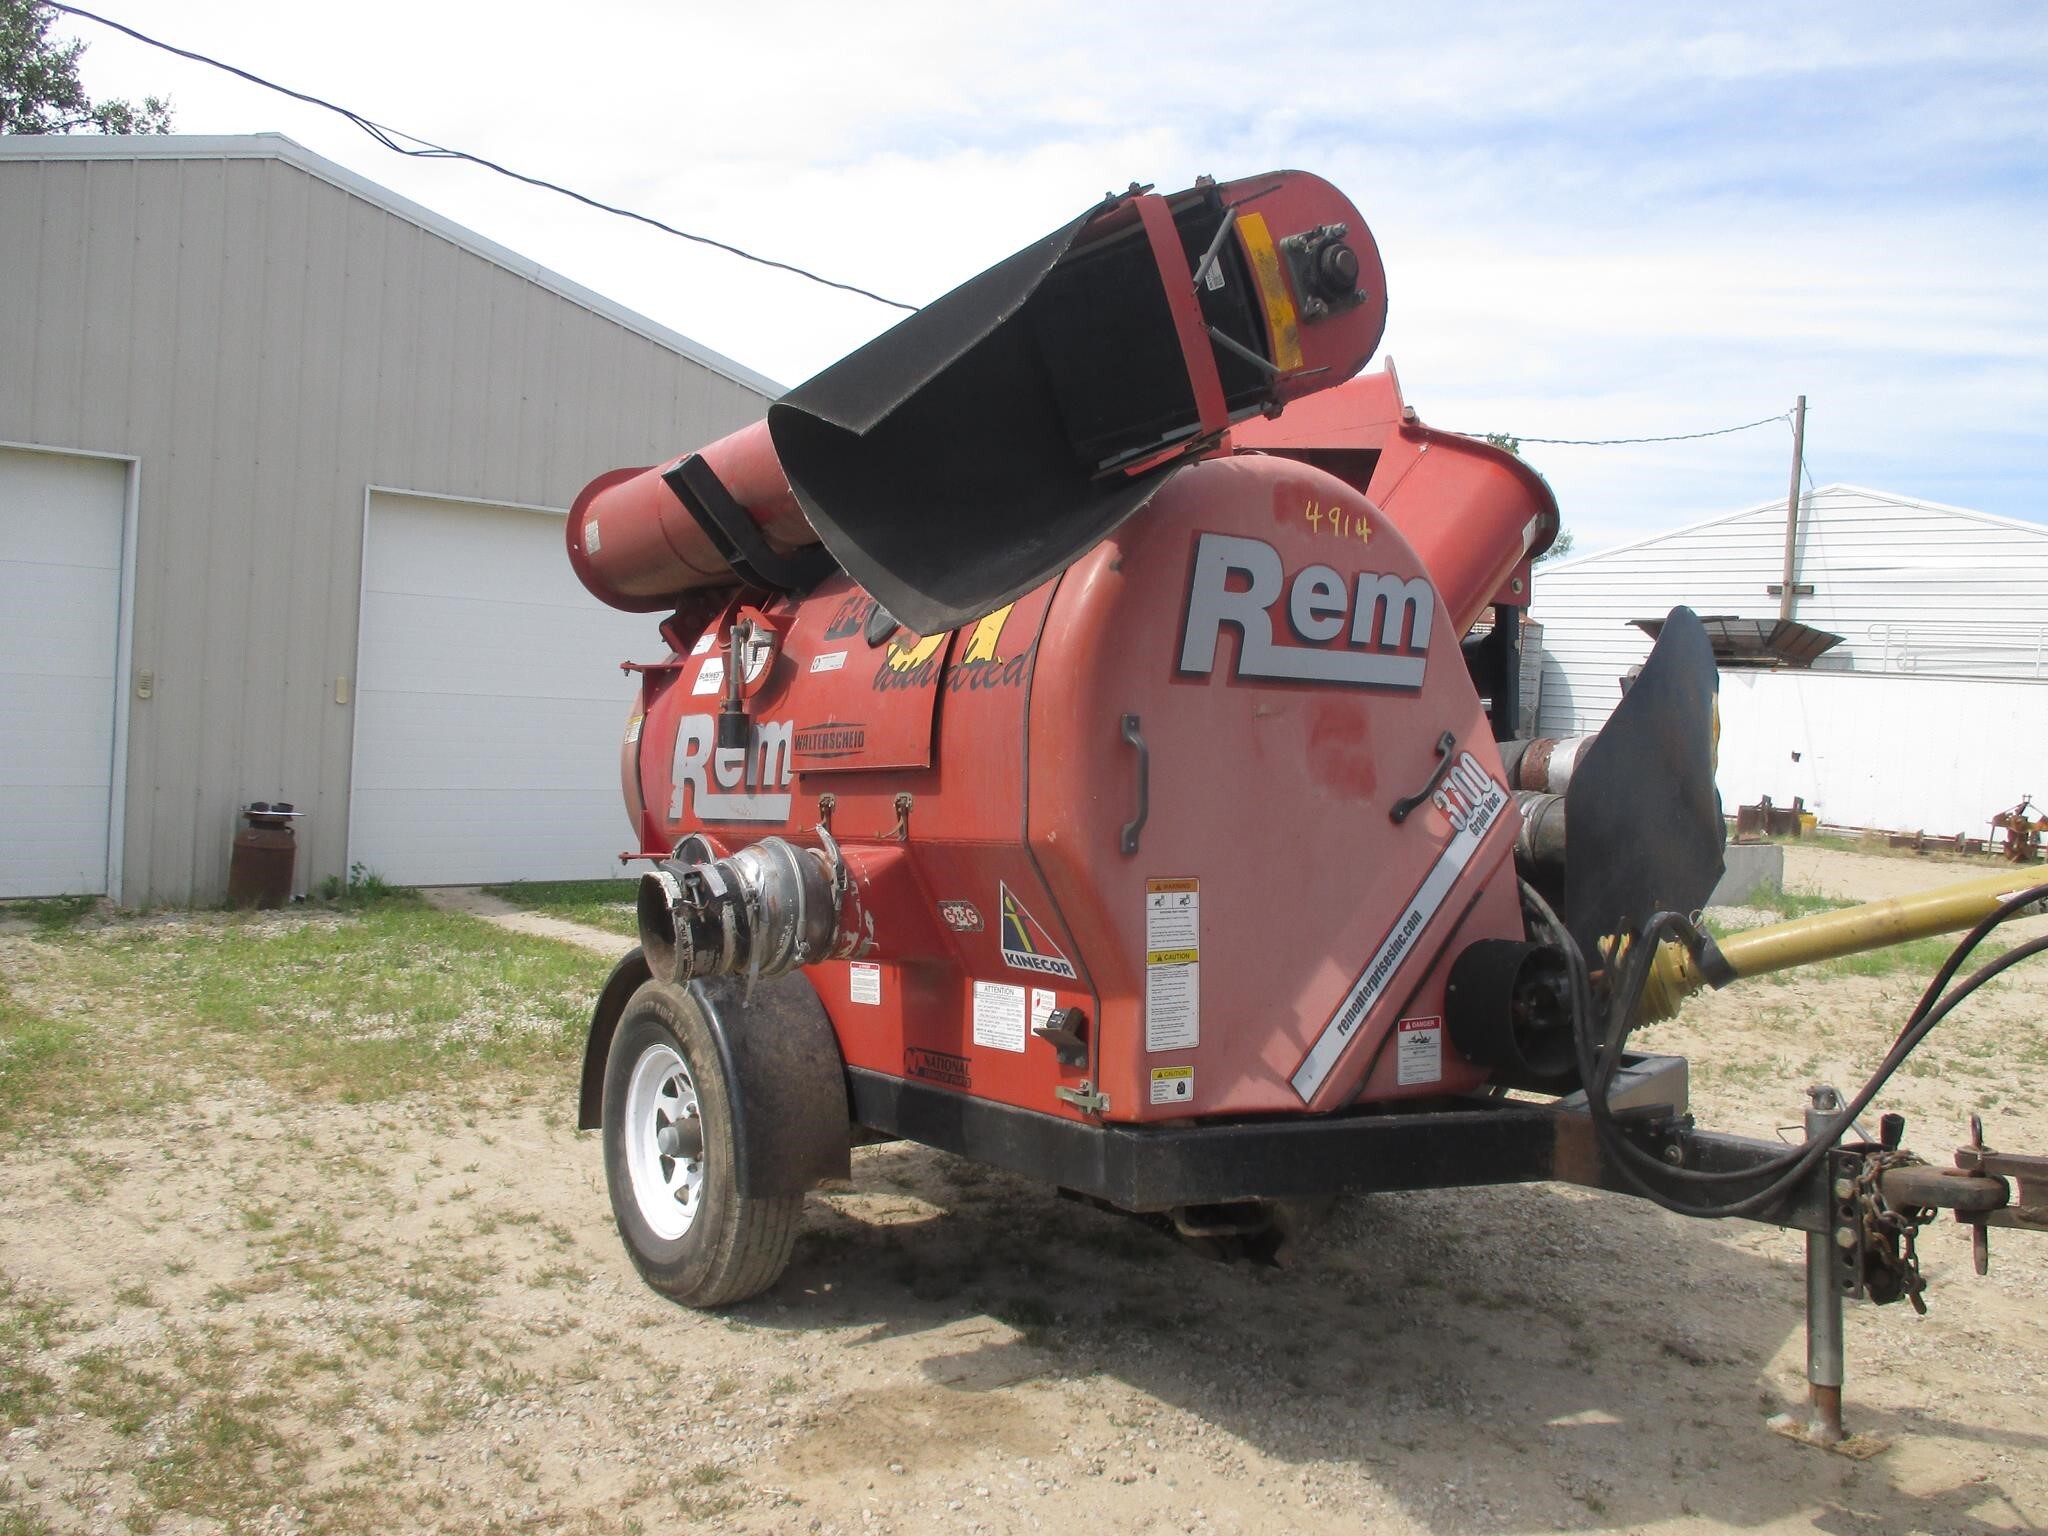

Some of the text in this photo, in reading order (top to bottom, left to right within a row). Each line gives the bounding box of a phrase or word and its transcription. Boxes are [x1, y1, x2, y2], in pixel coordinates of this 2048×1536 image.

[1304, 499, 1373, 544] 4914
[1178, 532, 1435, 687] Rem
[794, 730, 865, 751] WALTERSCHEID
[1432, 751, 1492, 832] 3700
[1468, 793, 1501, 836] Grain Vac
[1005, 952, 1075, 977] KINECOR
[1163, 953, 1190, 961] CAUTION
[1336, 910, 1423, 1037] rementerprisesinc.com
[984, 985, 1015, 996] ATTENTION
[1411, 1019, 1435, 1028] DANGER
[924, 1054, 970, 1077] NATIONAL
